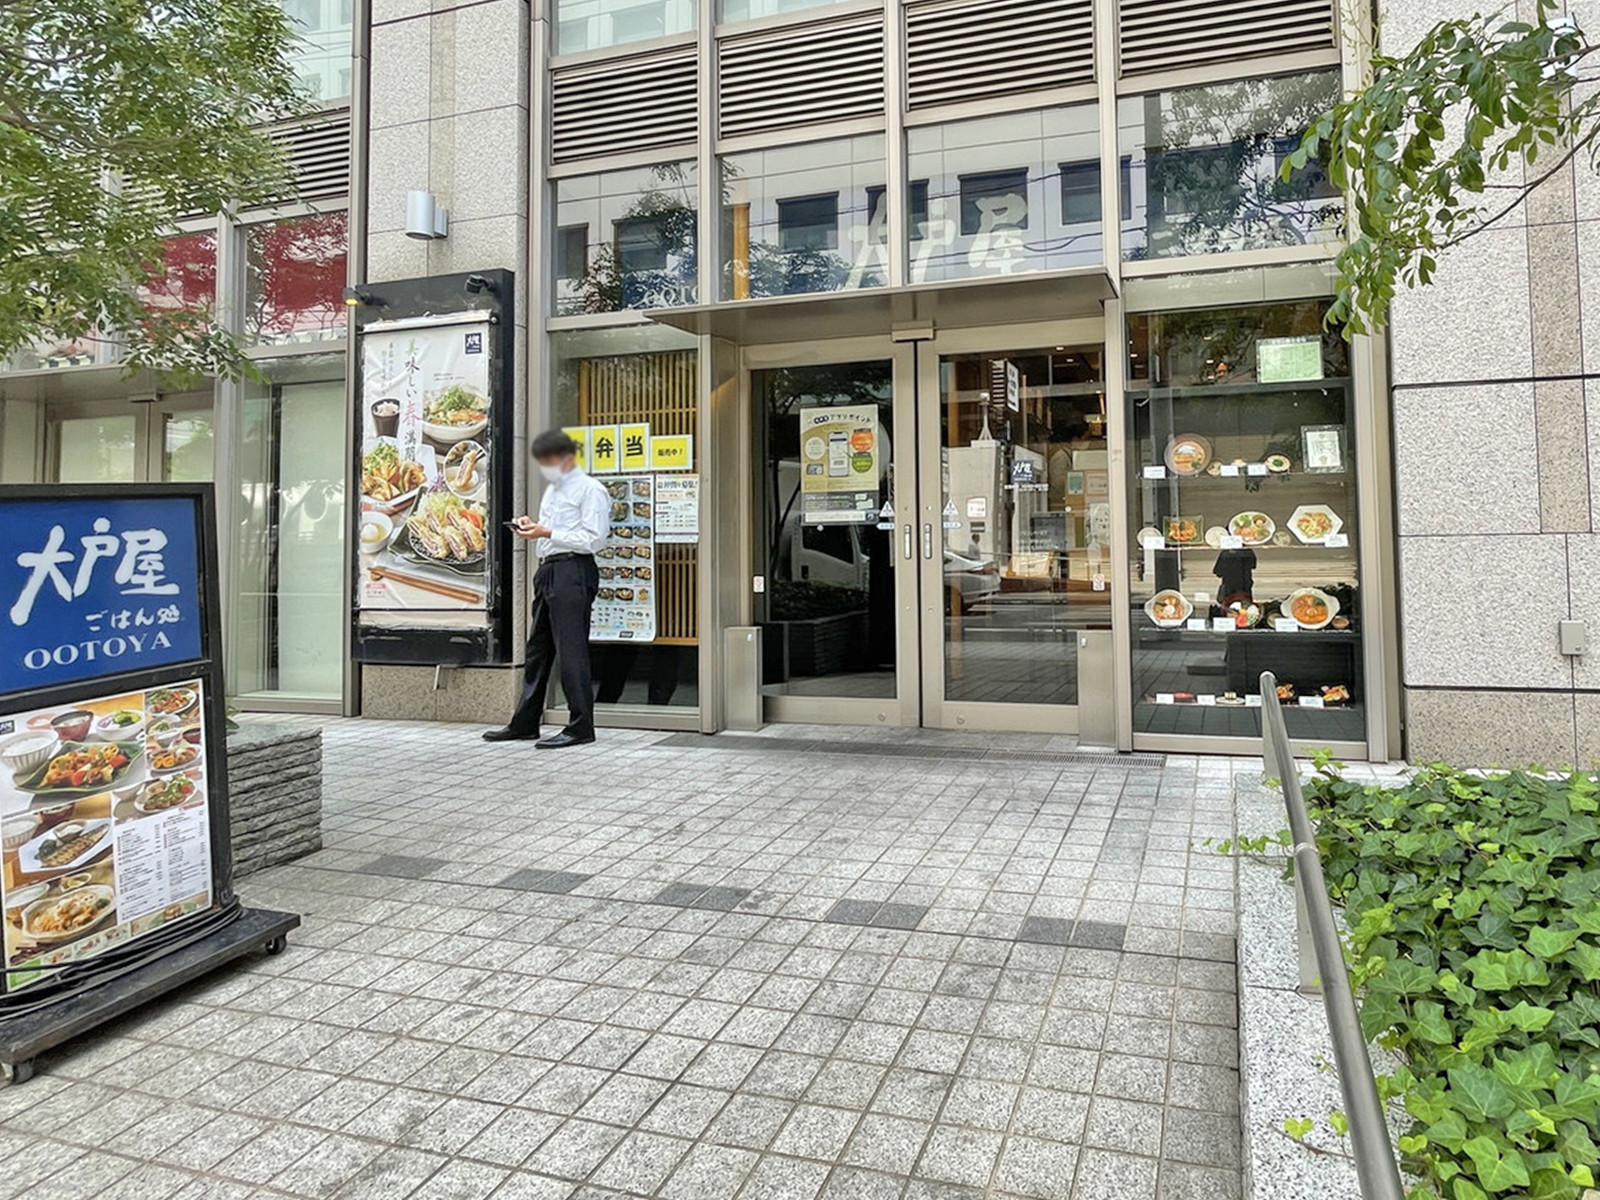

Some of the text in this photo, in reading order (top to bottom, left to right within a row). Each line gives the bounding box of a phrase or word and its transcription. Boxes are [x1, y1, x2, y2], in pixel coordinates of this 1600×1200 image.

[10, 517, 181, 626] 大戸屋
[24, 631, 172, 669] OOTOYA
